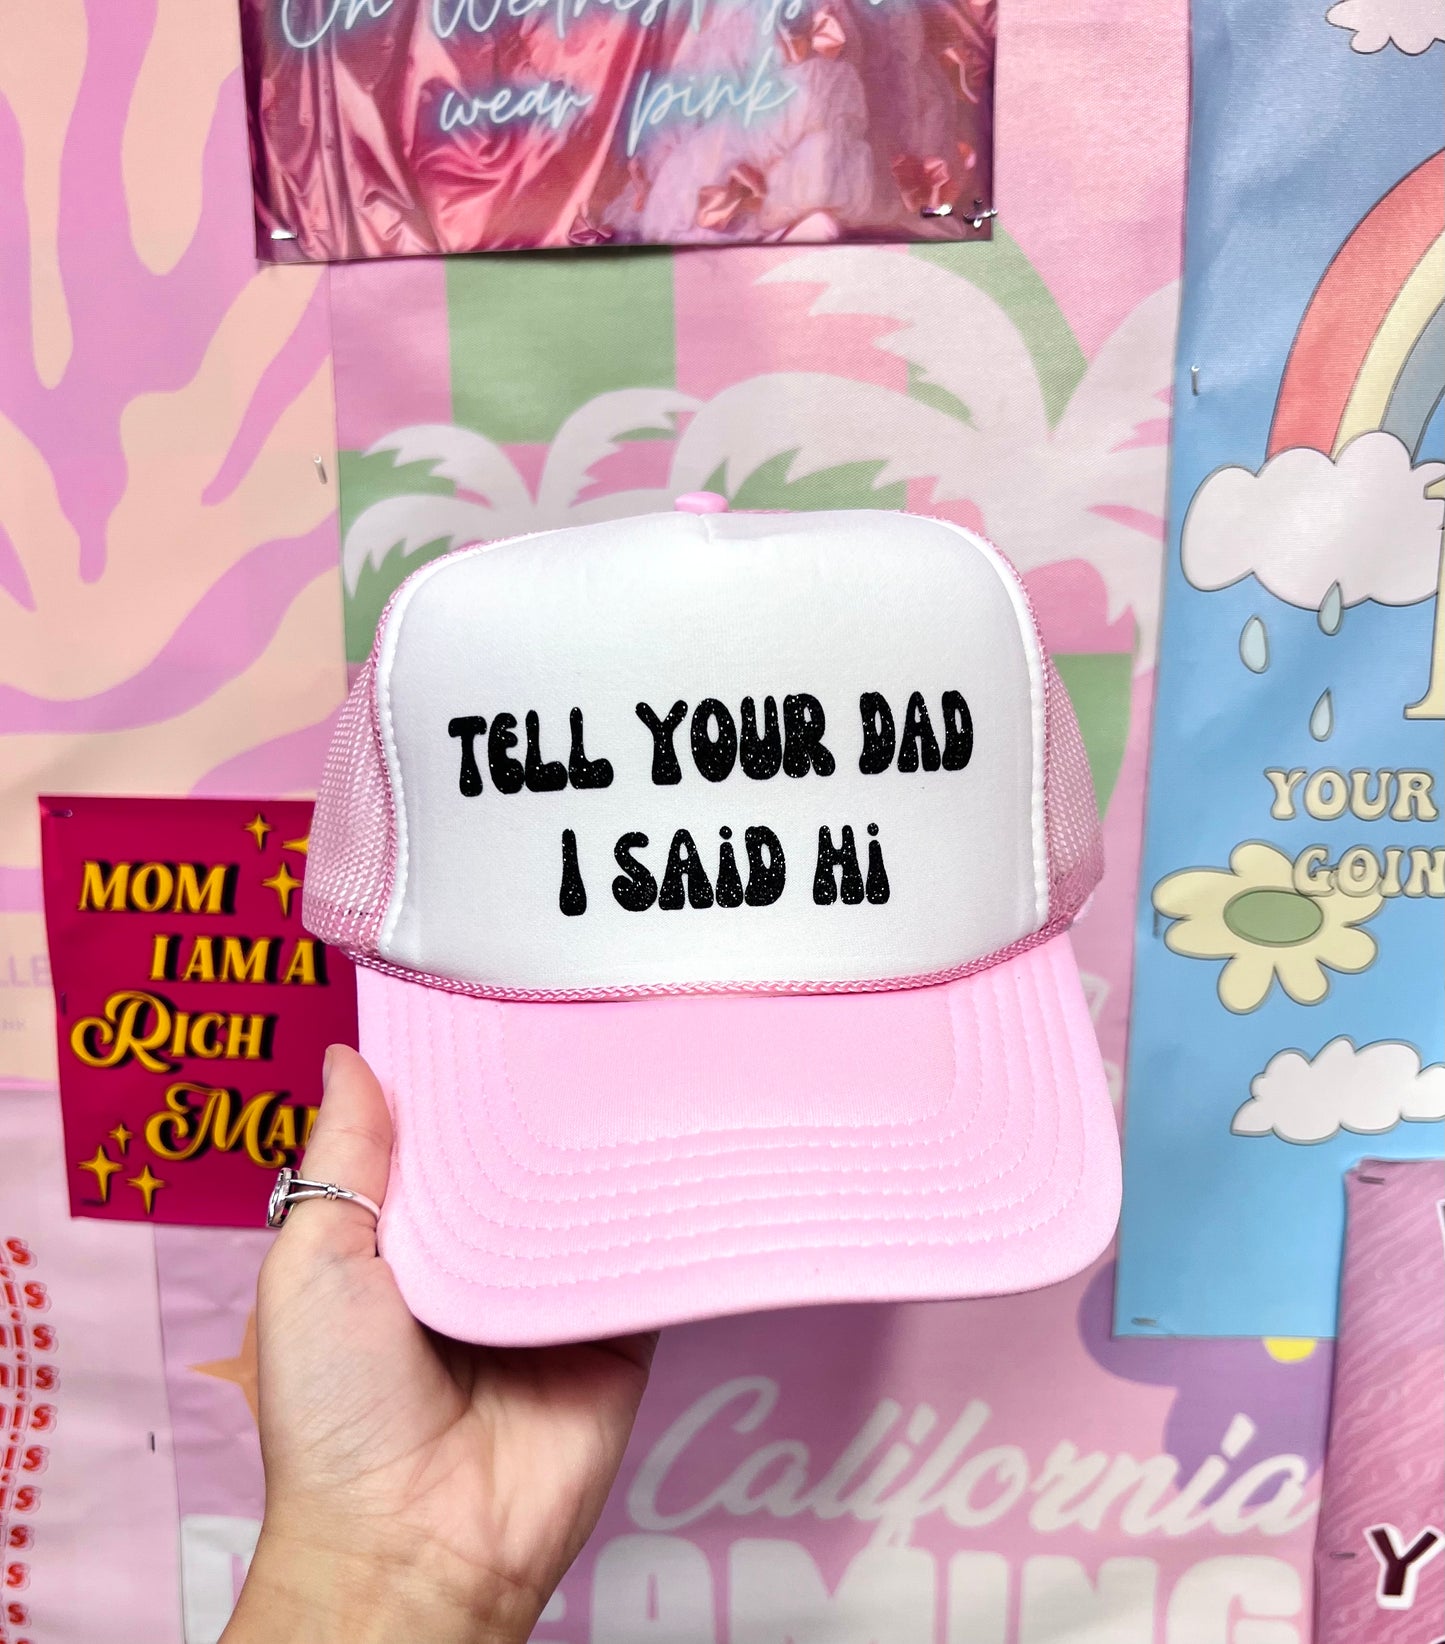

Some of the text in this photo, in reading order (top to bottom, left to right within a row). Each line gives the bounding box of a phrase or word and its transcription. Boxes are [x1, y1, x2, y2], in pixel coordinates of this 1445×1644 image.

[439, 46, 799, 158] wear pink
[448, 690, 974, 797] TELL YOUR DAD
[1263, 767, 1440, 822] YOUR
[77, 859, 236, 915] MOM
[559, 828, 587, 916] I
[150, 933, 323, 986] I AM A
[626, 1375, 1319, 1549] California
